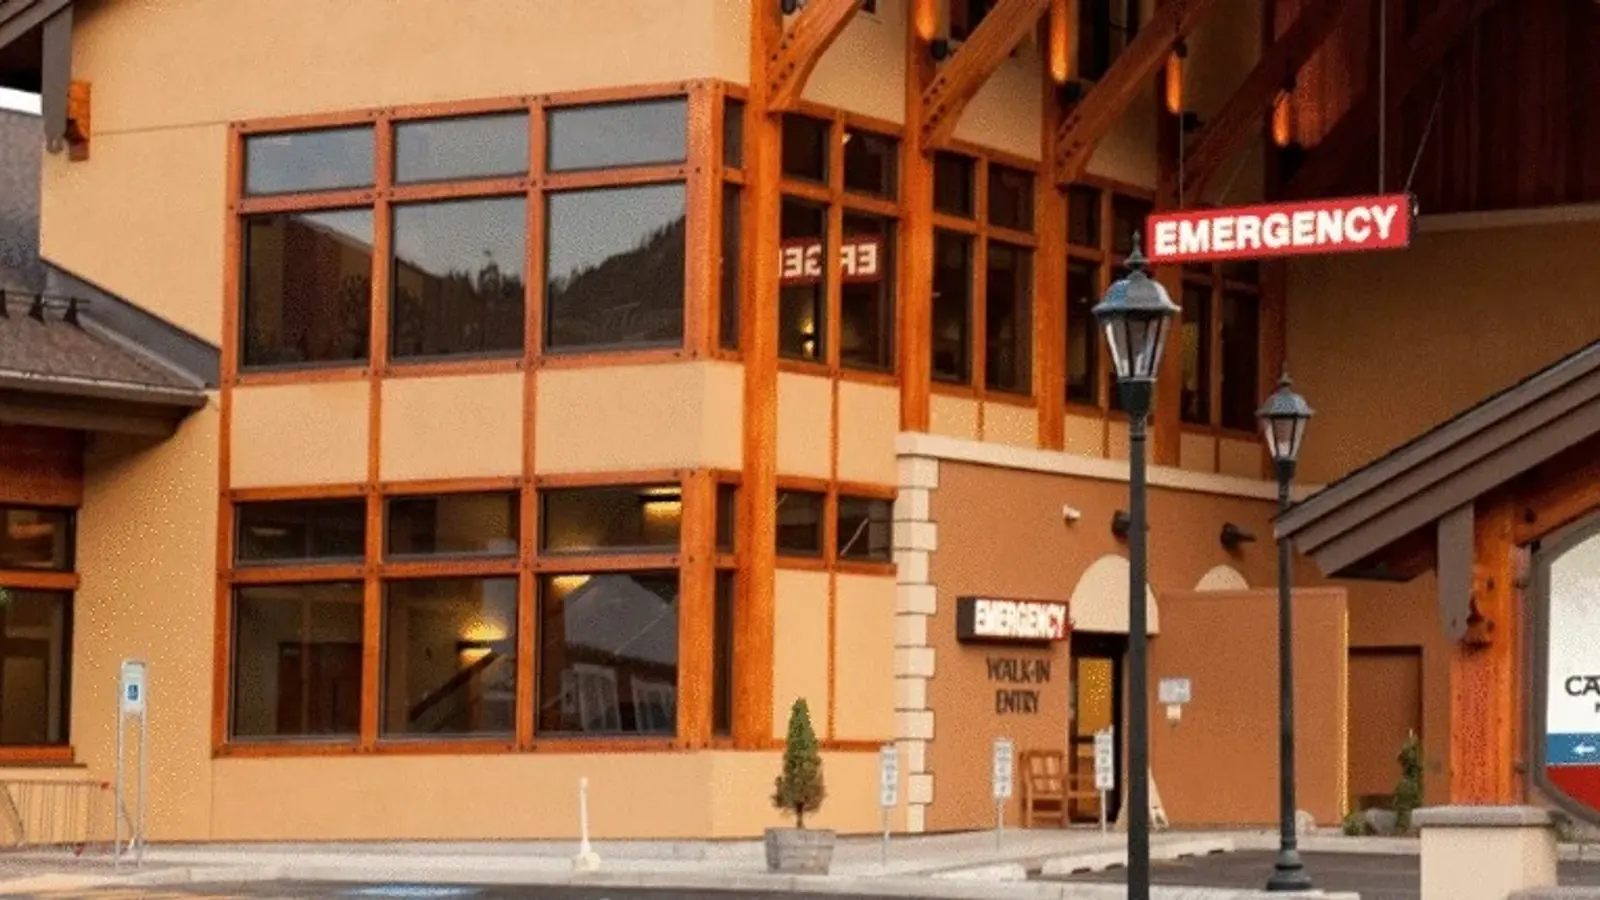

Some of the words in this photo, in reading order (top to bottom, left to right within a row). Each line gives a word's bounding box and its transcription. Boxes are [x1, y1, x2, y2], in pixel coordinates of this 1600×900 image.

[1154, 204, 1398, 255] EMERGENCY
[974, 599, 1067, 639] EMERGENCY
[986, 657, 1051, 683] WALK-IN
[996, 689, 1040, 714] ENTRY
